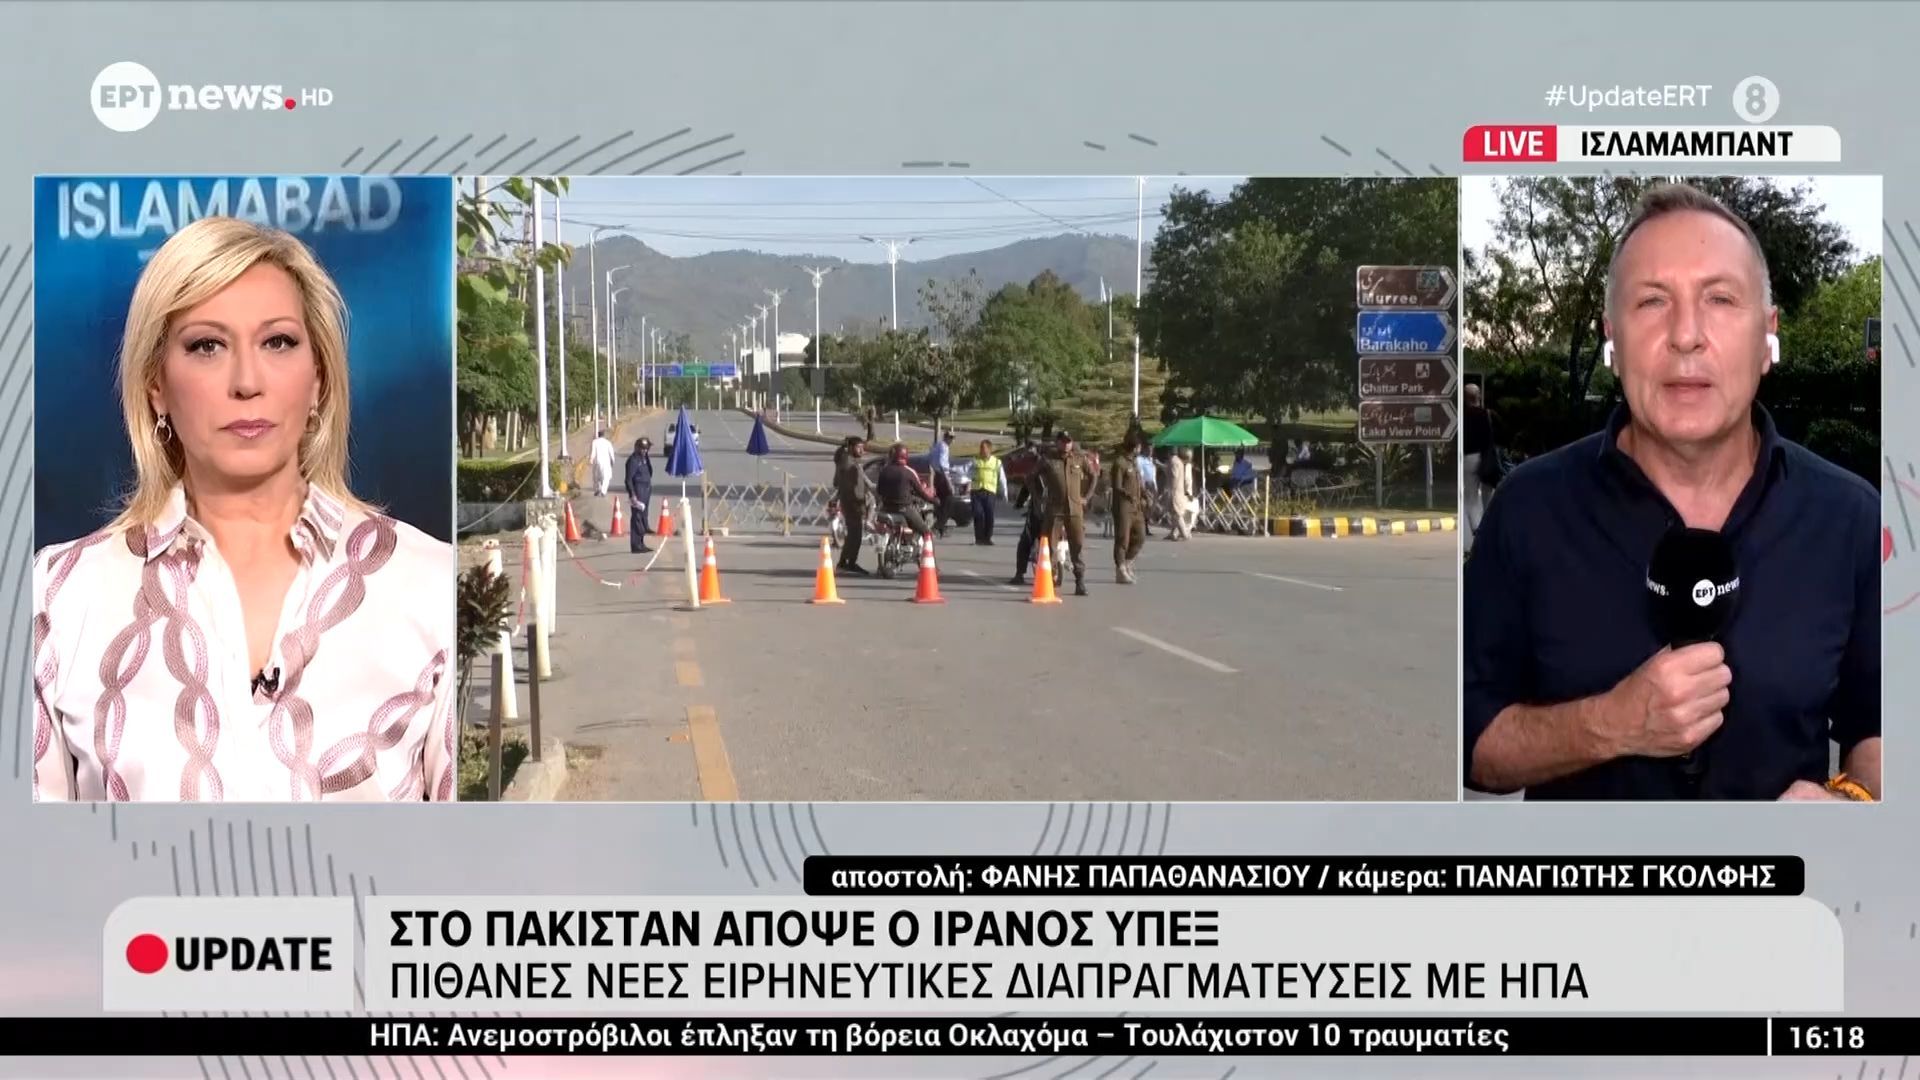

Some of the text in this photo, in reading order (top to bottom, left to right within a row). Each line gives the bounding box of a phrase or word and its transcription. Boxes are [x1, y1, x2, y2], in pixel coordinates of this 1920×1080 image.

[57, 177, 402, 239] ISLAMABAD
[1362, 293, 1418, 305] Murree
[1360, 338, 1429, 351] Barakaho
[1362, 383, 1424, 394] Chattar Park
[1362, 426, 1441, 438] Lake View Point
